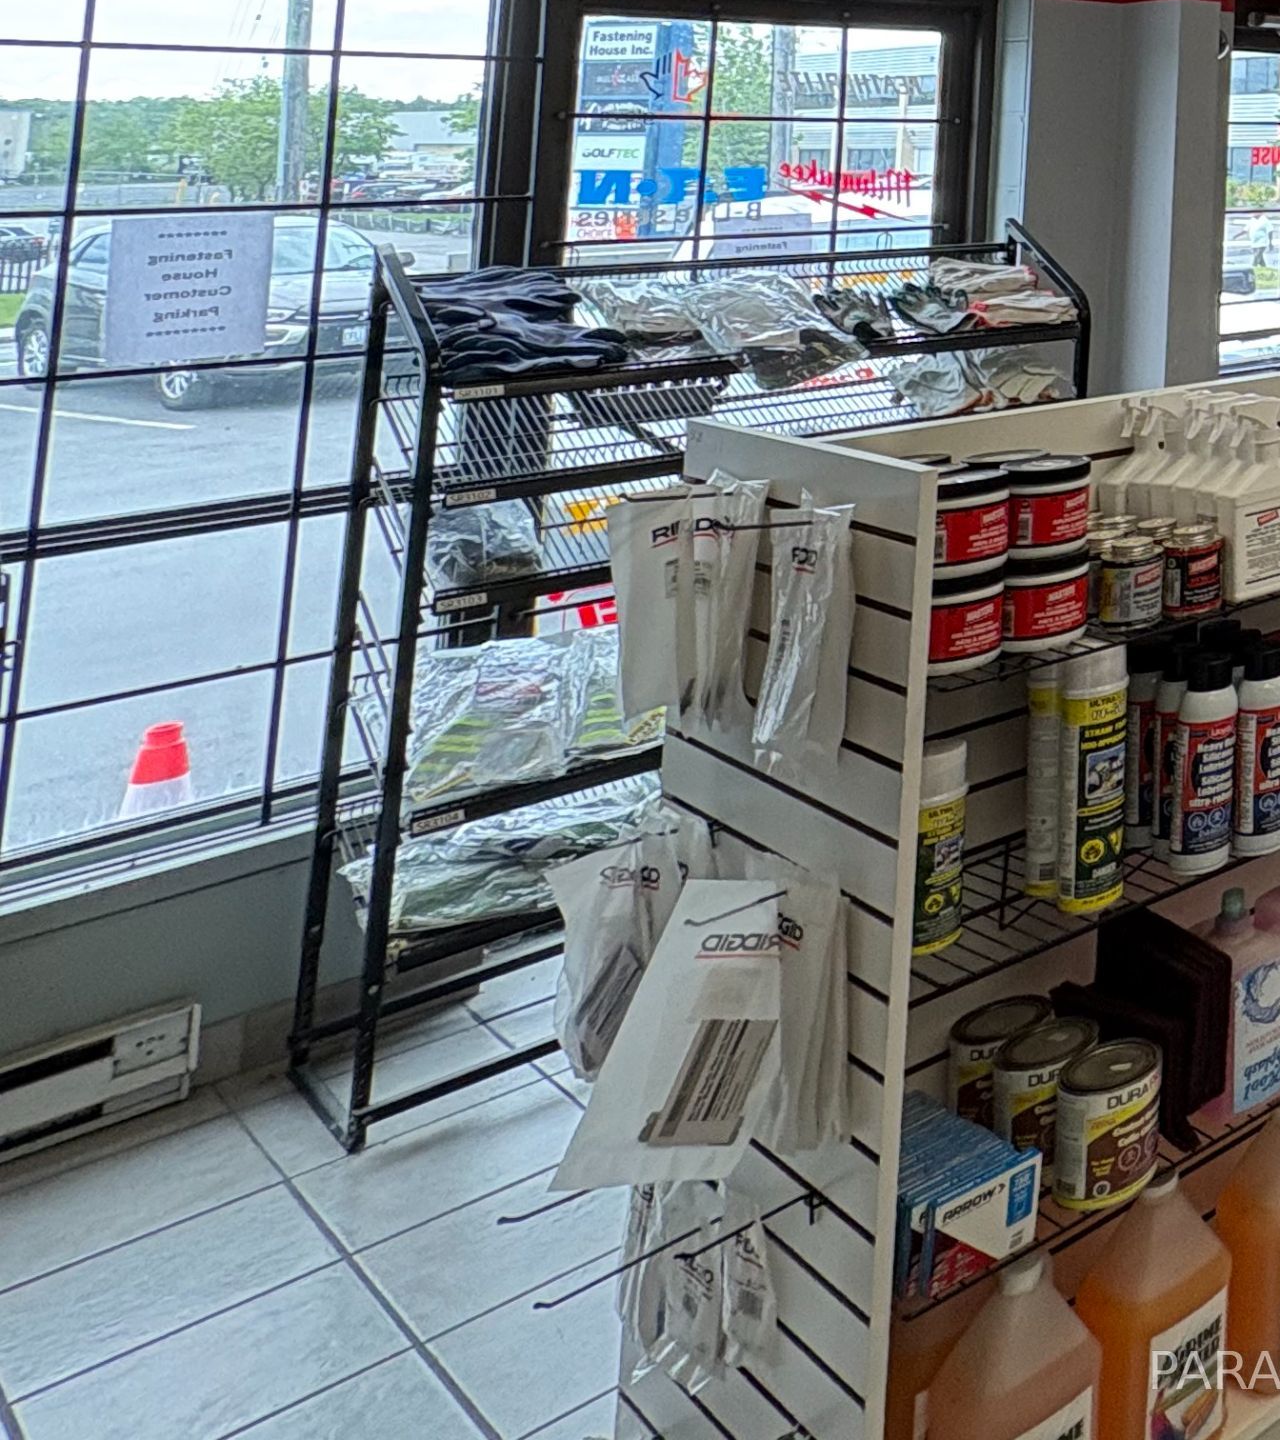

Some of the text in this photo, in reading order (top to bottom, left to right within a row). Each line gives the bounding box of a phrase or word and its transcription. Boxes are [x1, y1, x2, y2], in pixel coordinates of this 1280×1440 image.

[592, 29, 653, 45] Fastening
[589, 43, 654, 57] House Inc.
[582, 147, 640, 159] GOLFTEC
[942, 1186, 998, 1224] ARROW
